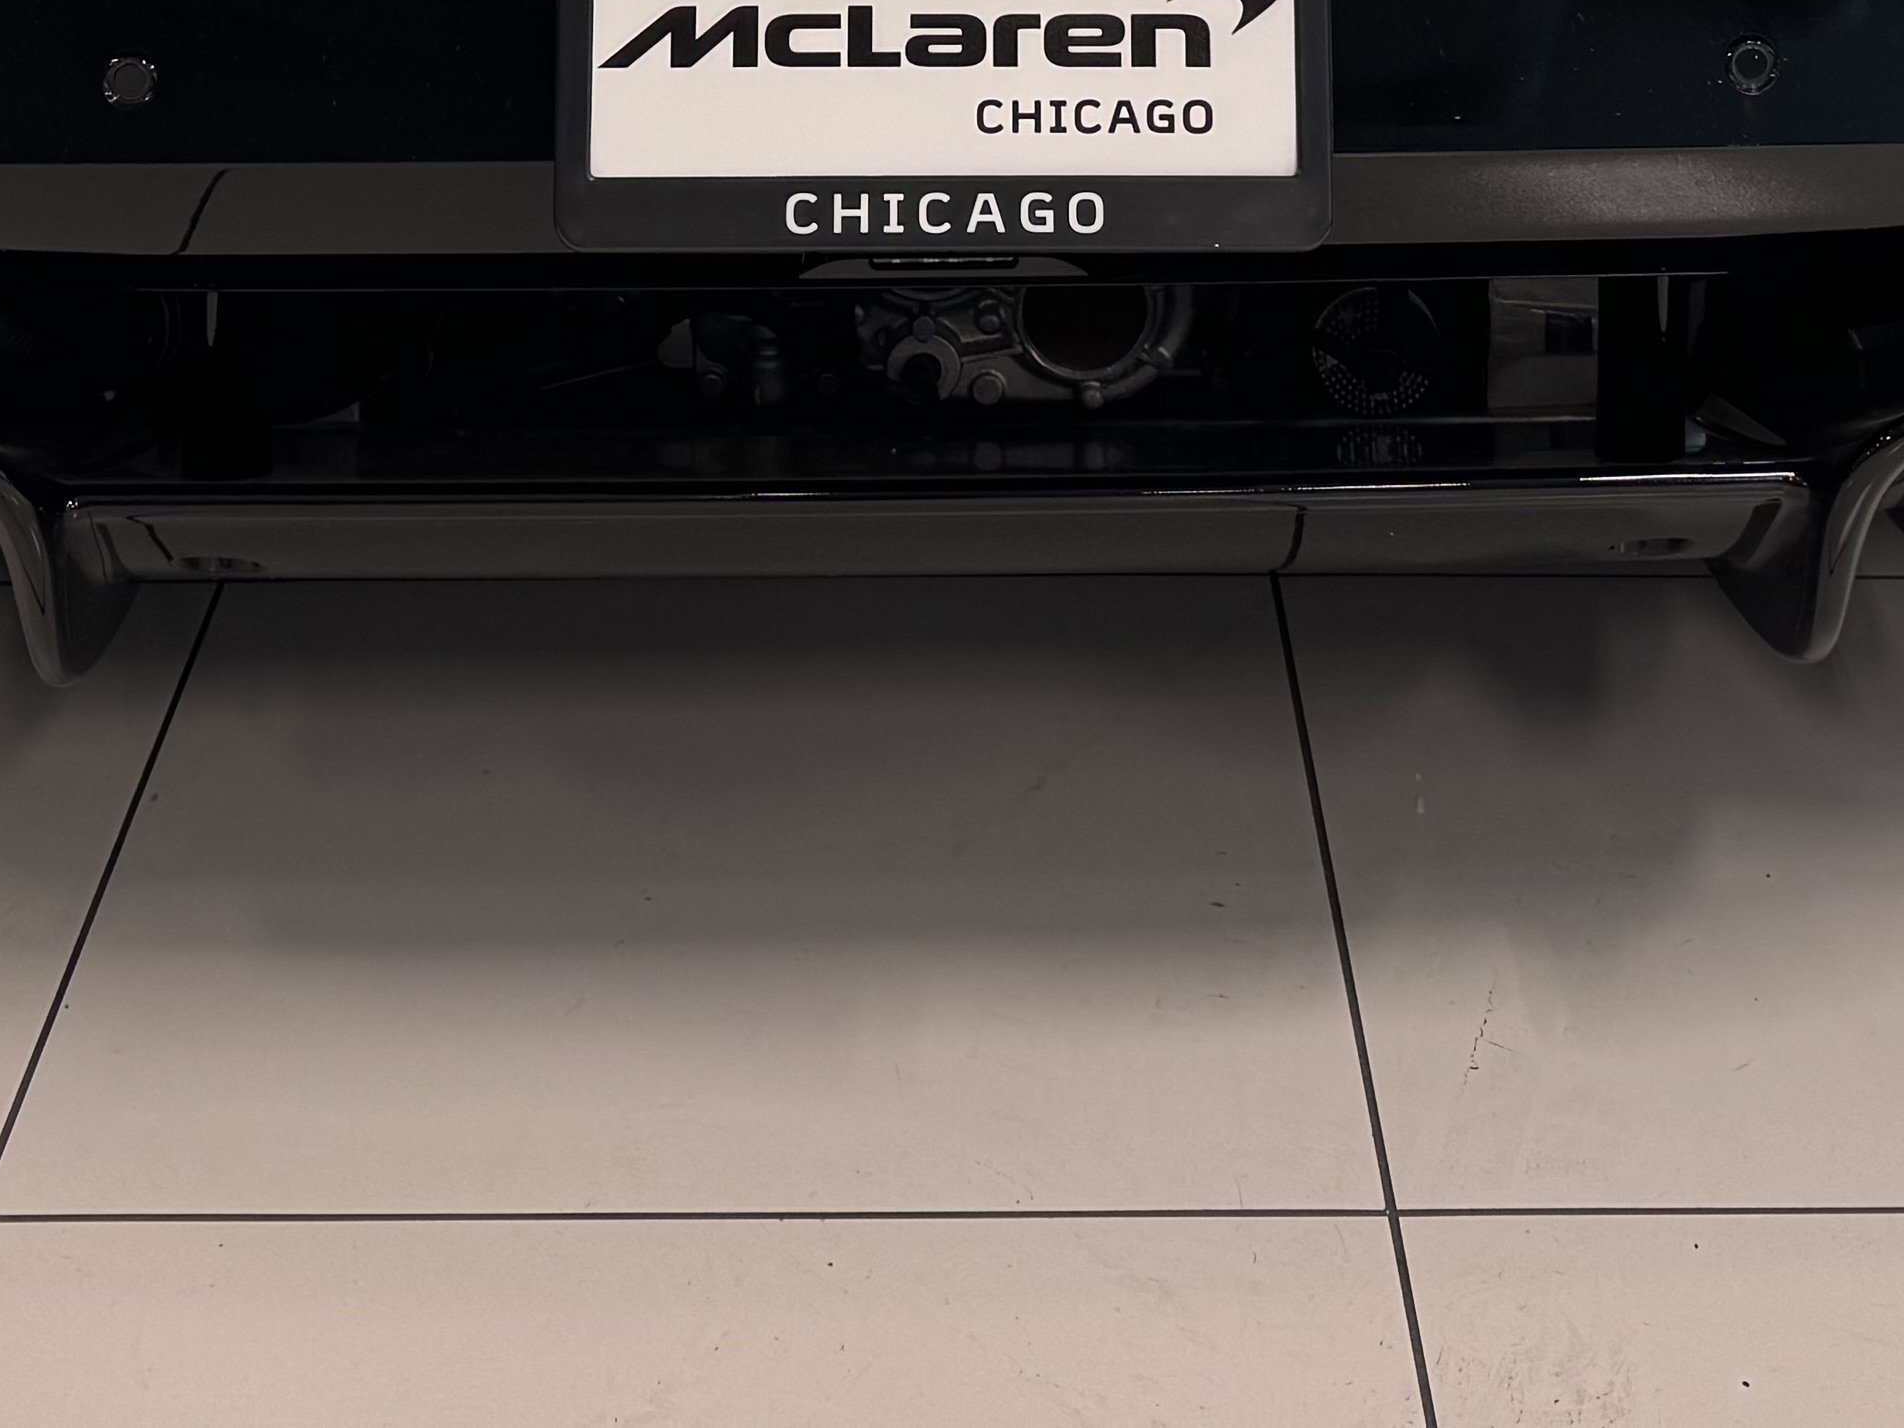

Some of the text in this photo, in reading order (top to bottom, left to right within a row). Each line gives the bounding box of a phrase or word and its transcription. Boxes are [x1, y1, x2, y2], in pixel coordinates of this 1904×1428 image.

[597, 5, 1212, 70] McLaren
[975, 98, 1215, 135] CHICAGO
[784, 191, 1106, 235] CHICAGO
